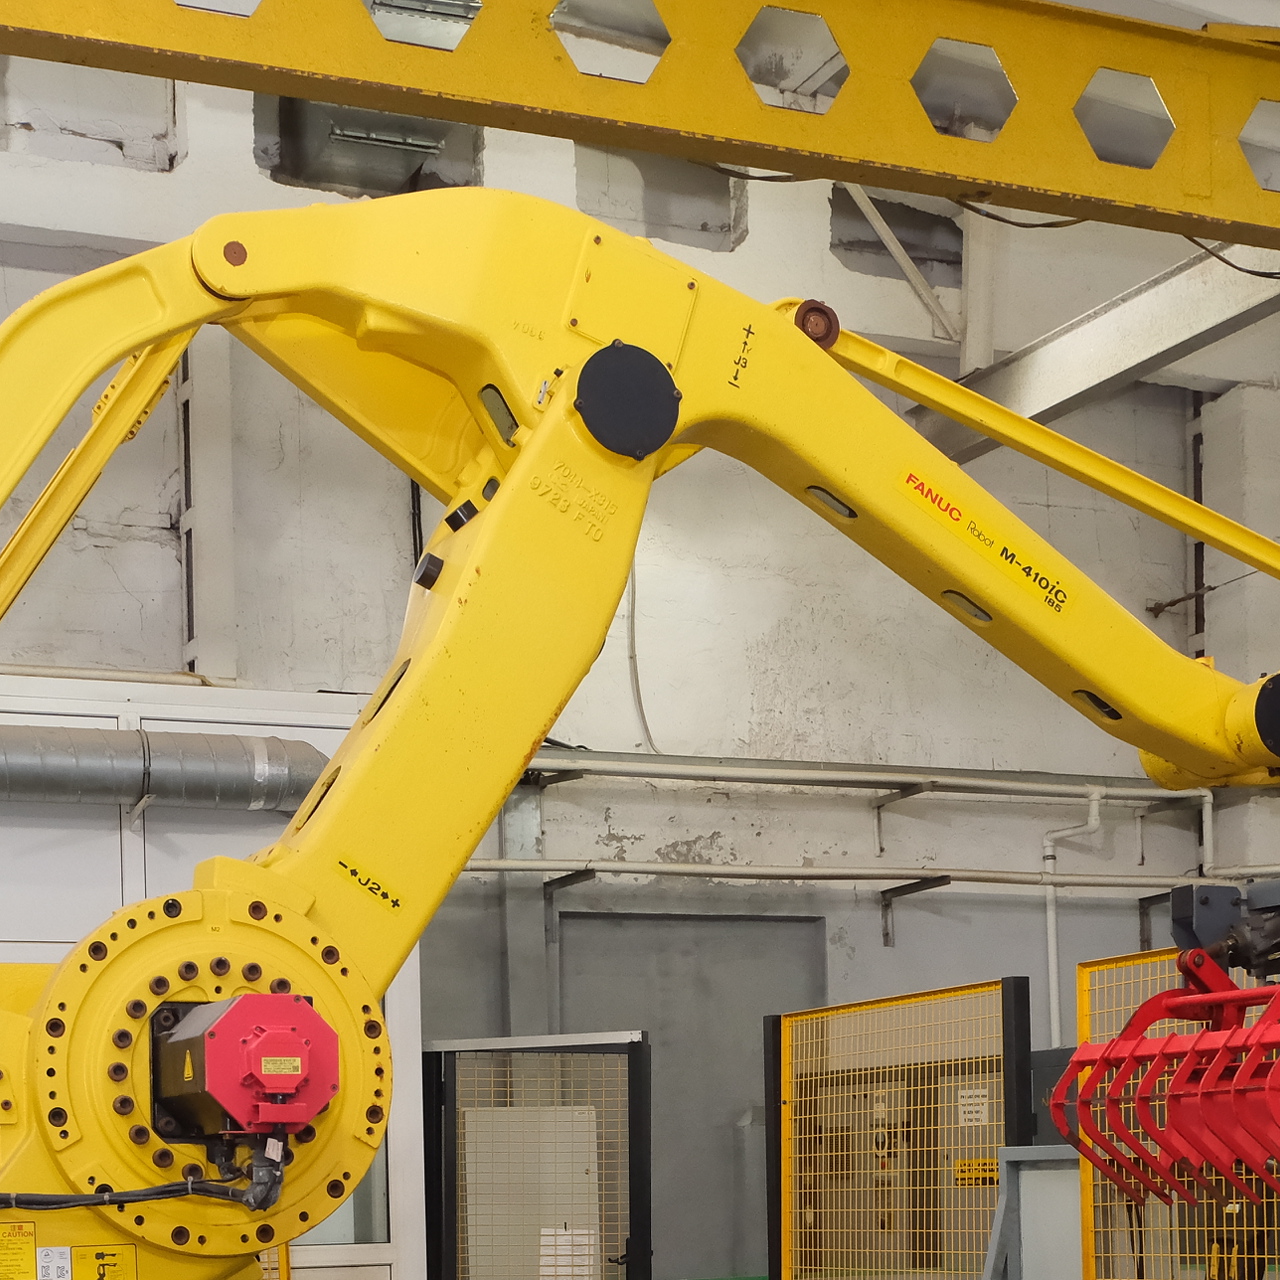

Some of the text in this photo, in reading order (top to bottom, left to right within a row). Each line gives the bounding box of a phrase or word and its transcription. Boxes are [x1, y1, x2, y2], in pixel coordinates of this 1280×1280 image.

[733, 355, 748, 368] J3
[905, 472, 962, 522] FANUC
[966, 520, 995, 549] Robot
[1043, 595, 1063, 613] 185
[358, 877, 381, 896] J2
[1, 1231, 34, 1239] CAUTION
